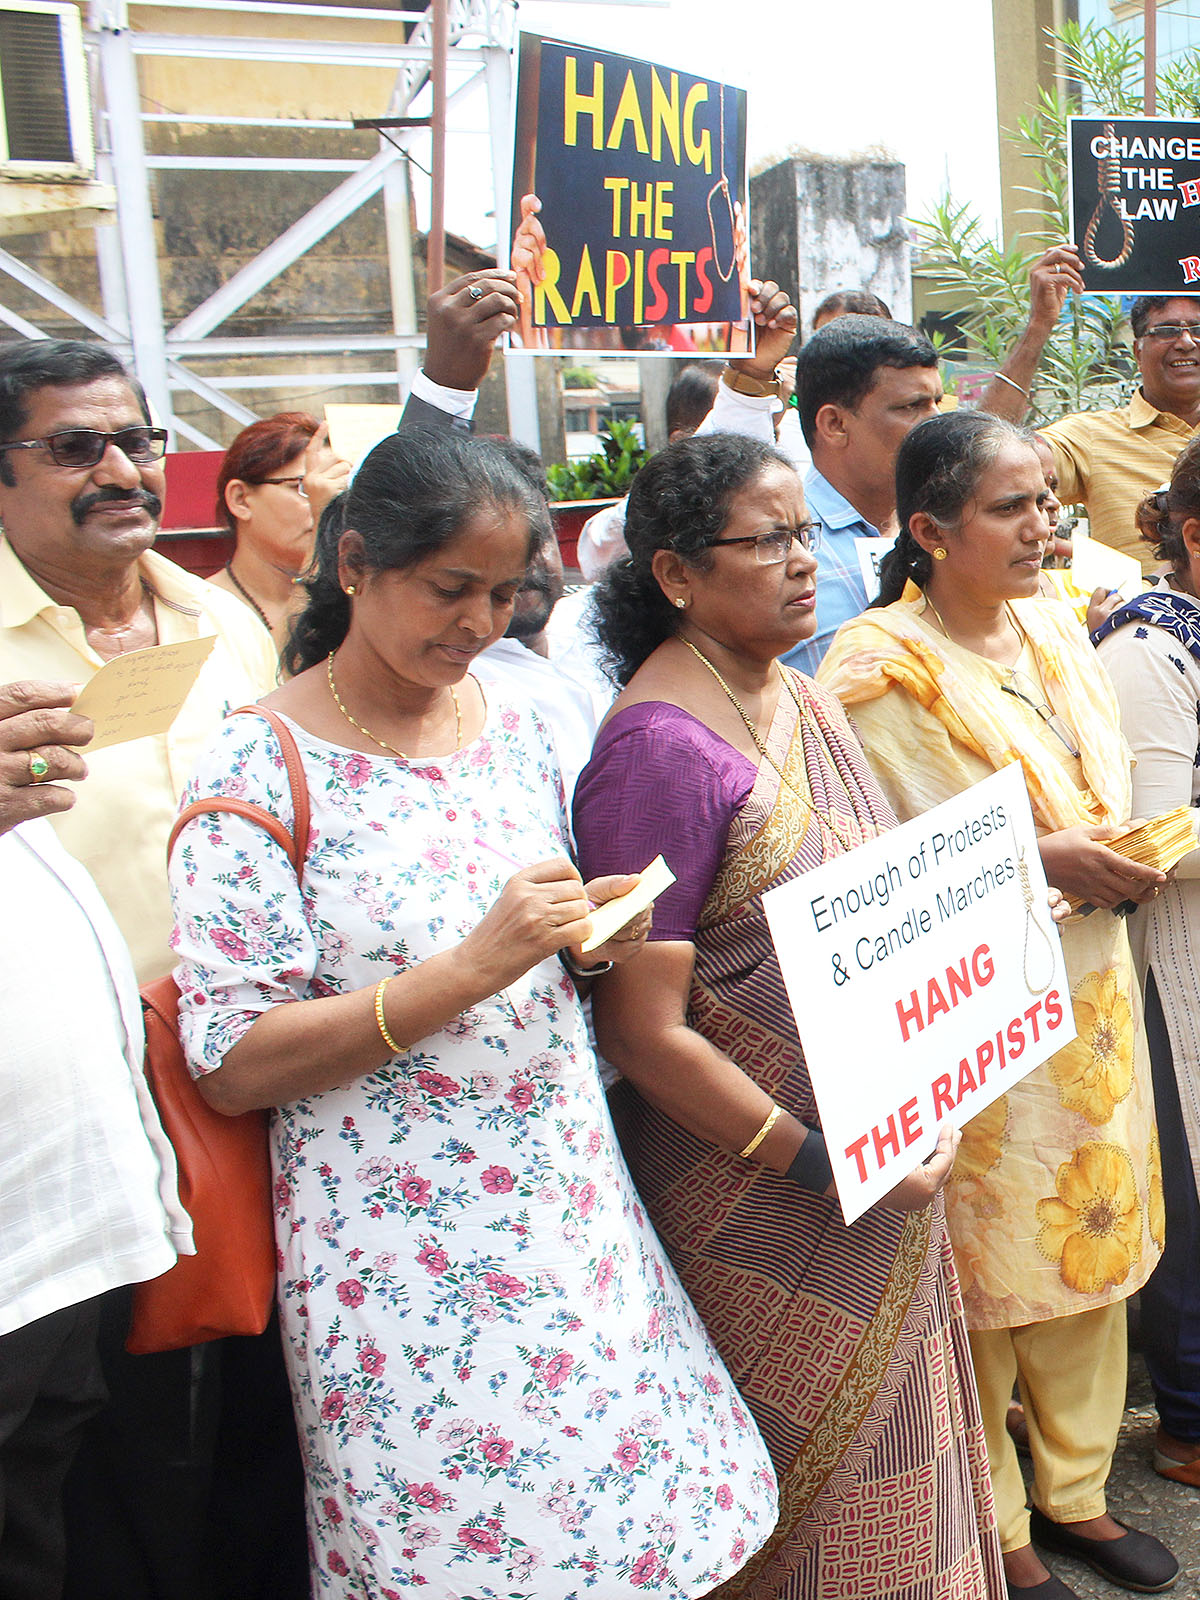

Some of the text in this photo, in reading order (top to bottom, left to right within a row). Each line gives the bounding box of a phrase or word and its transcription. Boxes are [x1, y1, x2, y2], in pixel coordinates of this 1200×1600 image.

[564, 55, 712, 174] HANG
[604, 177, 673, 240] THE
[1121, 167, 1174, 191] THE
[1121, 197, 1177, 222] LAW
[534, 244, 713, 325] RAPISTS
[810, 804, 1007, 933] Enough of Protests
[831, 856, 1016, 987] & Candle Marches
[895, 943, 996, 1042] HANG
[844, 990, 1064, 1184] THE RAPISTS
